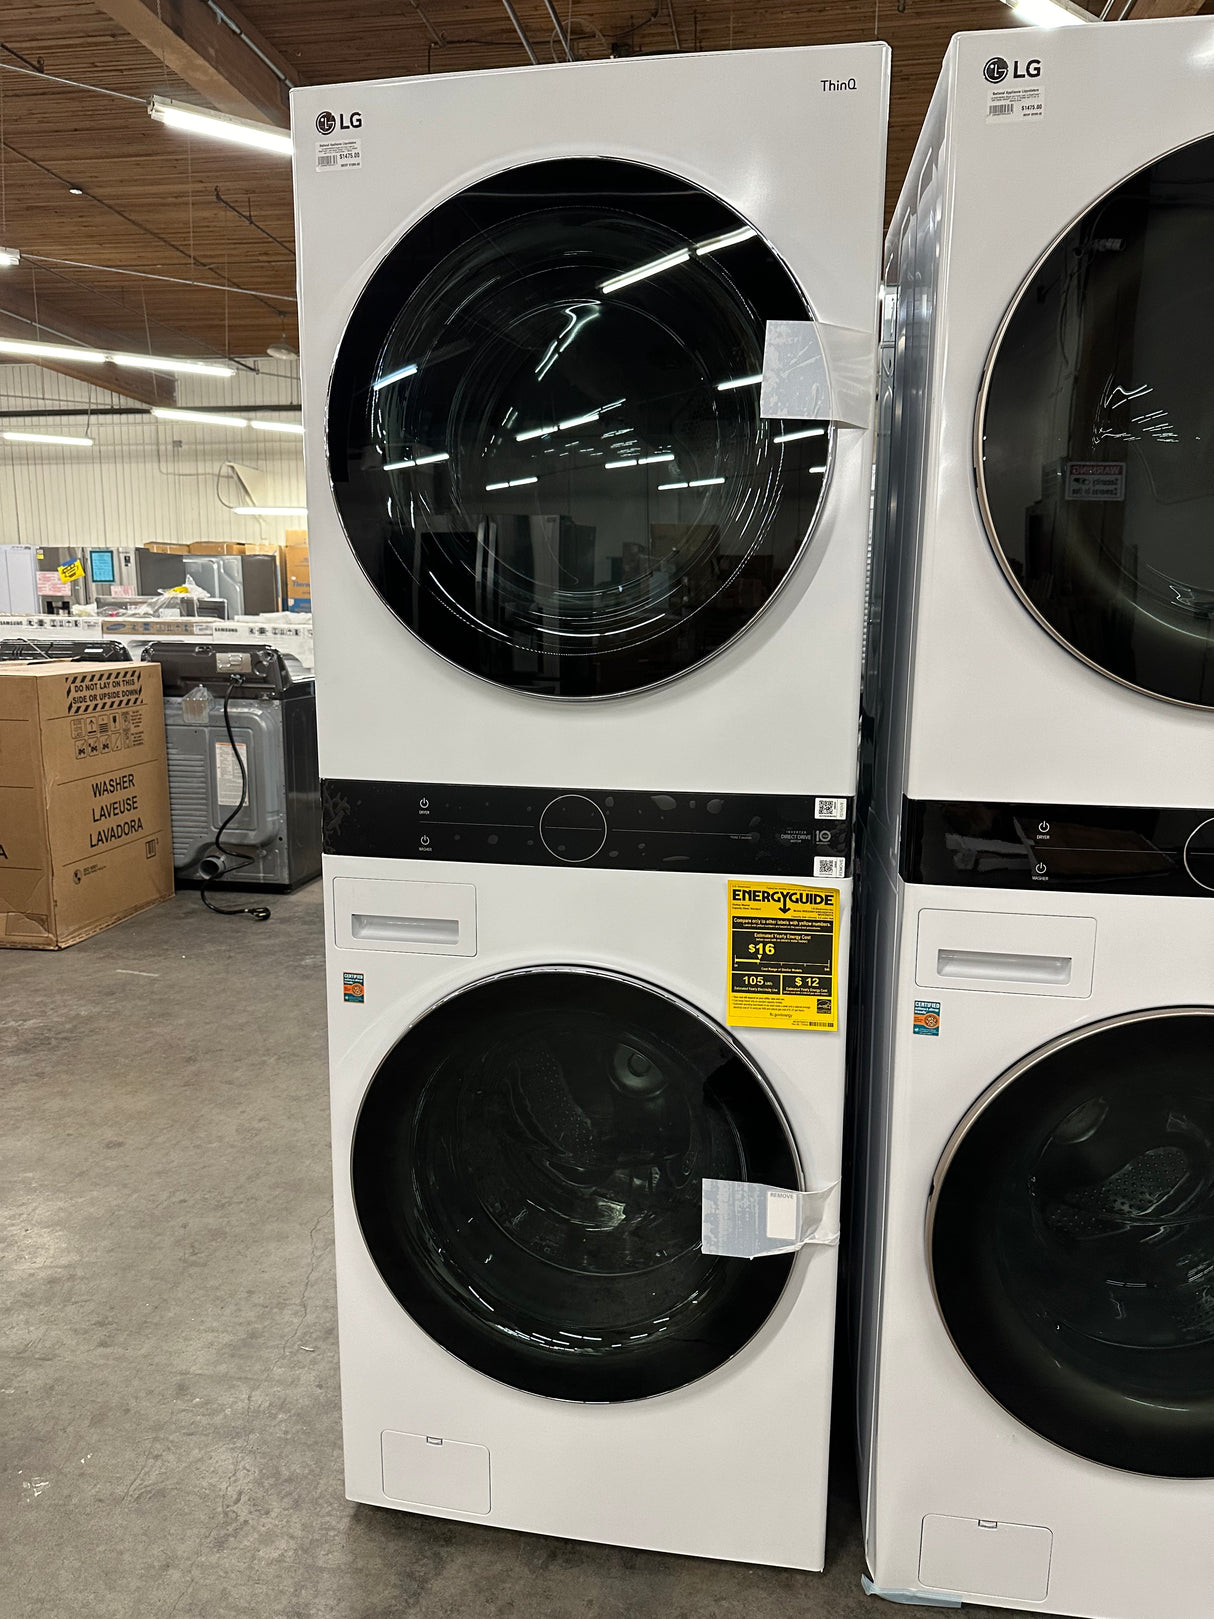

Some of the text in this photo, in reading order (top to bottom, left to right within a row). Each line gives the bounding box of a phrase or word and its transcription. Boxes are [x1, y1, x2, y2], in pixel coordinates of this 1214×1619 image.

[1013, 59, 1041, 78] LG
[820, 78, 857, 91] ThinQ
[339, 112, 362, 130] LG
[339, 152, 360, 160] $1475.00
[75, 678, 135, 693] DO NOT LAY ON THIS
[73, 689, 139, 705] SIDE OR UPSIDE DOWN
[91, 773, 136, 799] WASHER
[92, 795, 139, 823] LAVEUSE
[89, 817, 144, 849] LAVADORA
[732, 889, 834, 906] ENERGYGUIDE
[748, 943, 775, 955] $16
[743, 976, 764, 985] 105
[795, 976, 820, 987] $ 12
[770, 1192, 794, 1200] REMOVE
